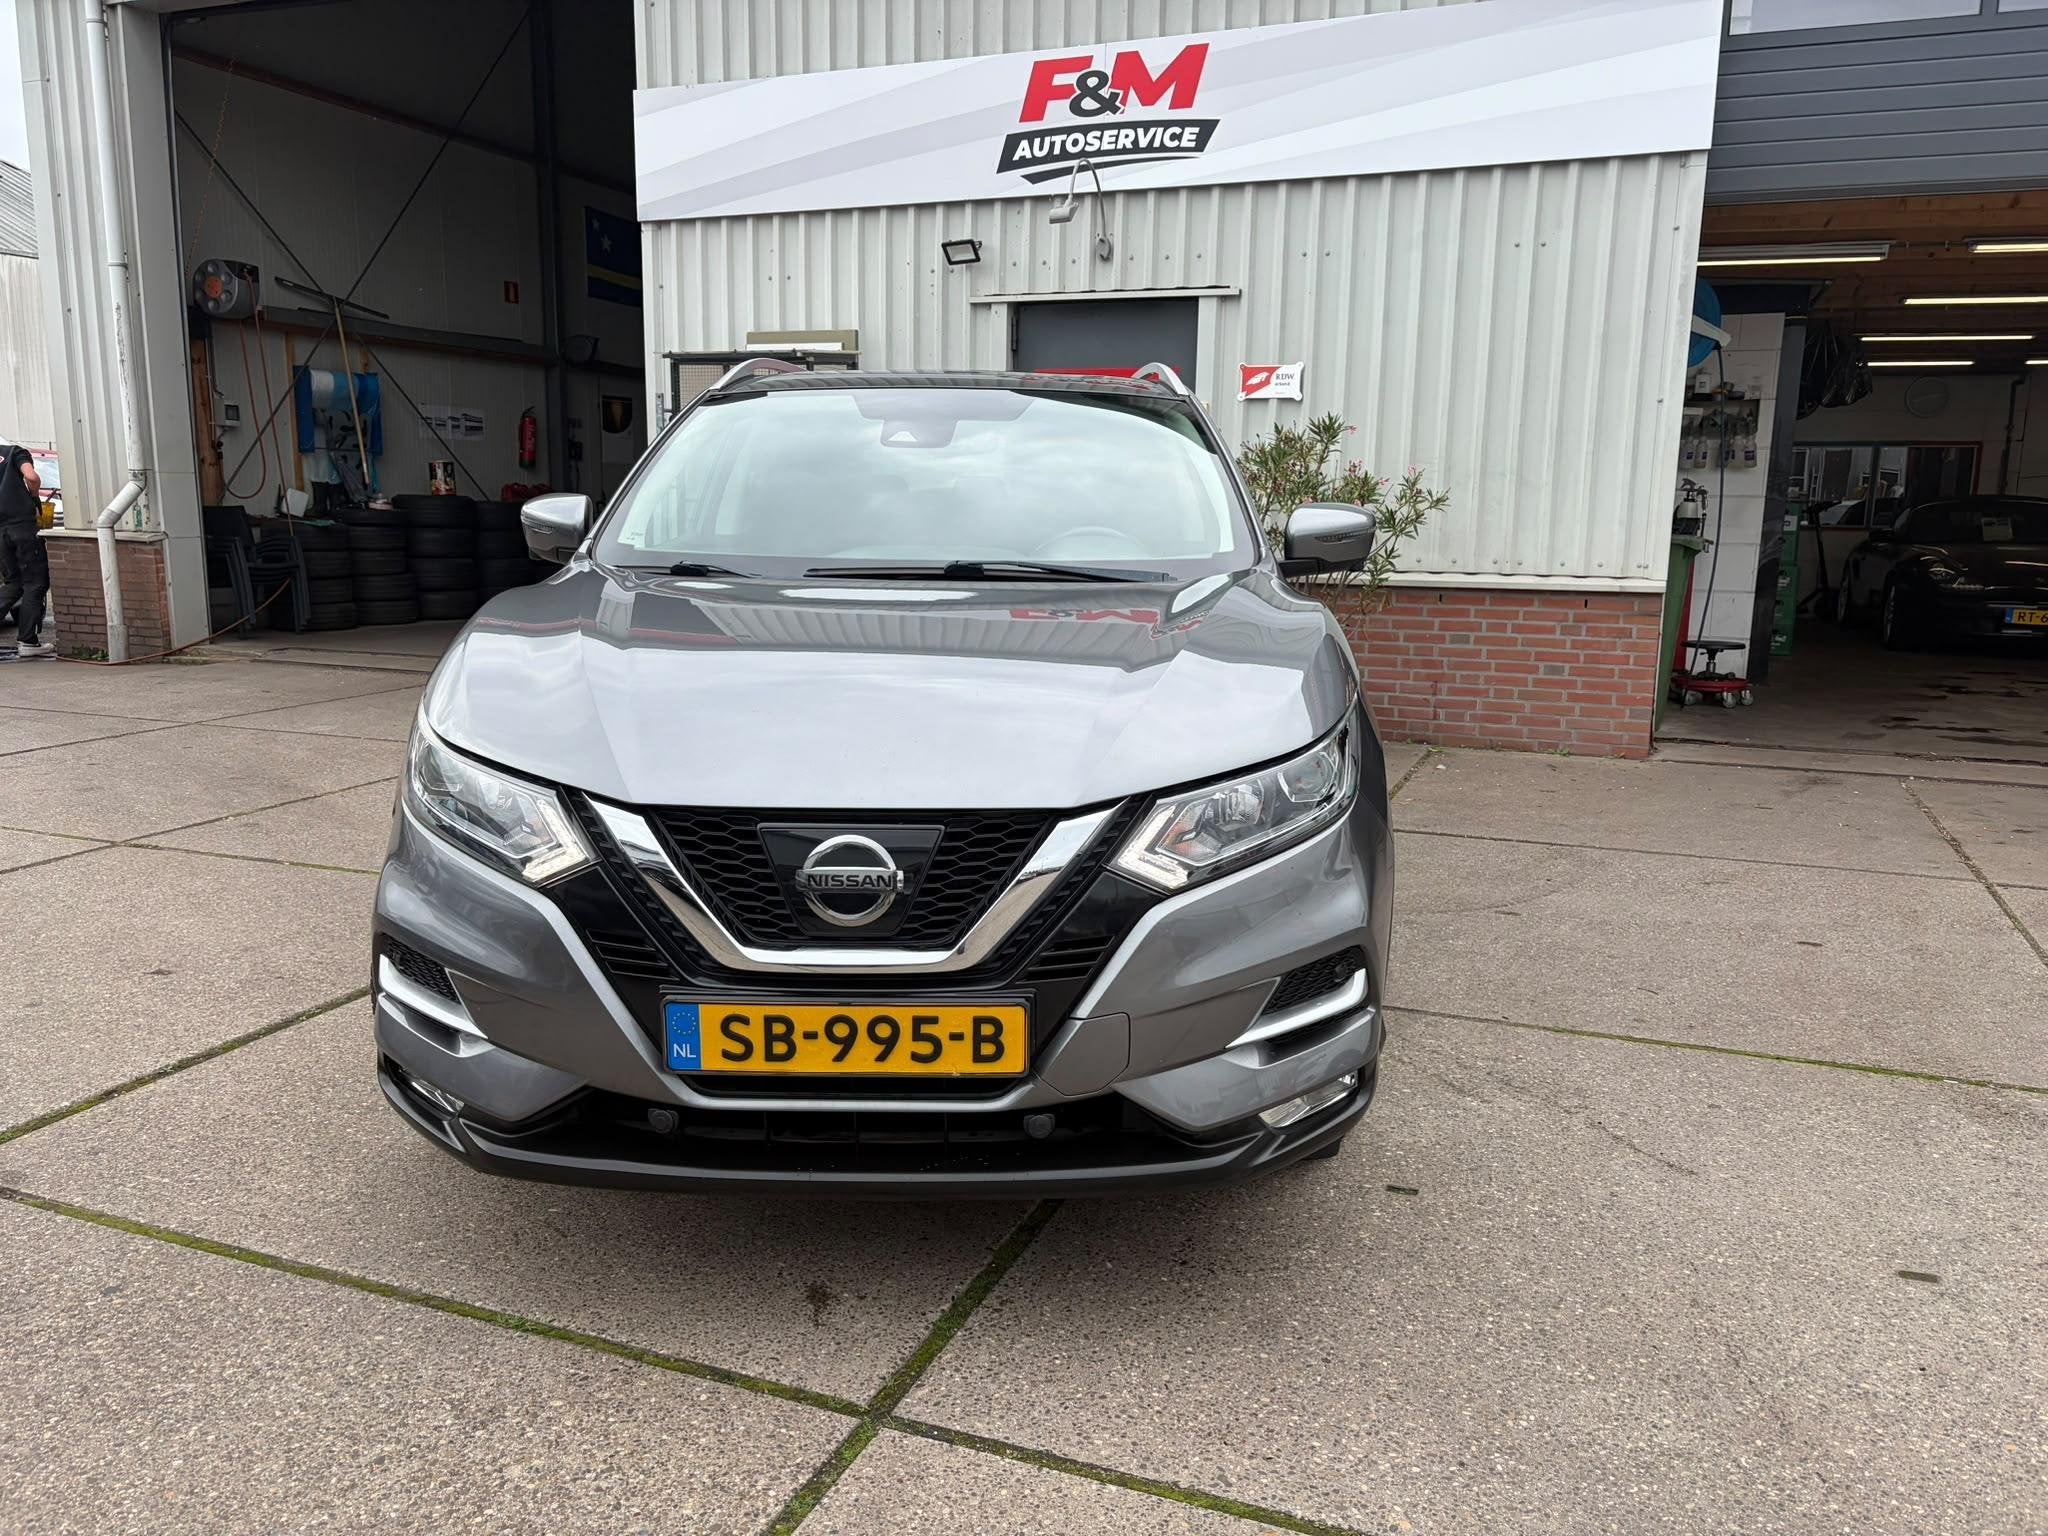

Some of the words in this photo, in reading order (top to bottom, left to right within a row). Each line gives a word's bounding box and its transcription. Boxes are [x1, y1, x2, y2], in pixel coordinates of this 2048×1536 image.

[1019, 43, 1210, 123] F&M
[1012, 126, 1201, 161] AUTOSERVICE
[807, 874, 892, 888] NISSAN
[673, 1043, 697, 1058] NL
[720, 1013, 1006, 1064] SB-995-B
